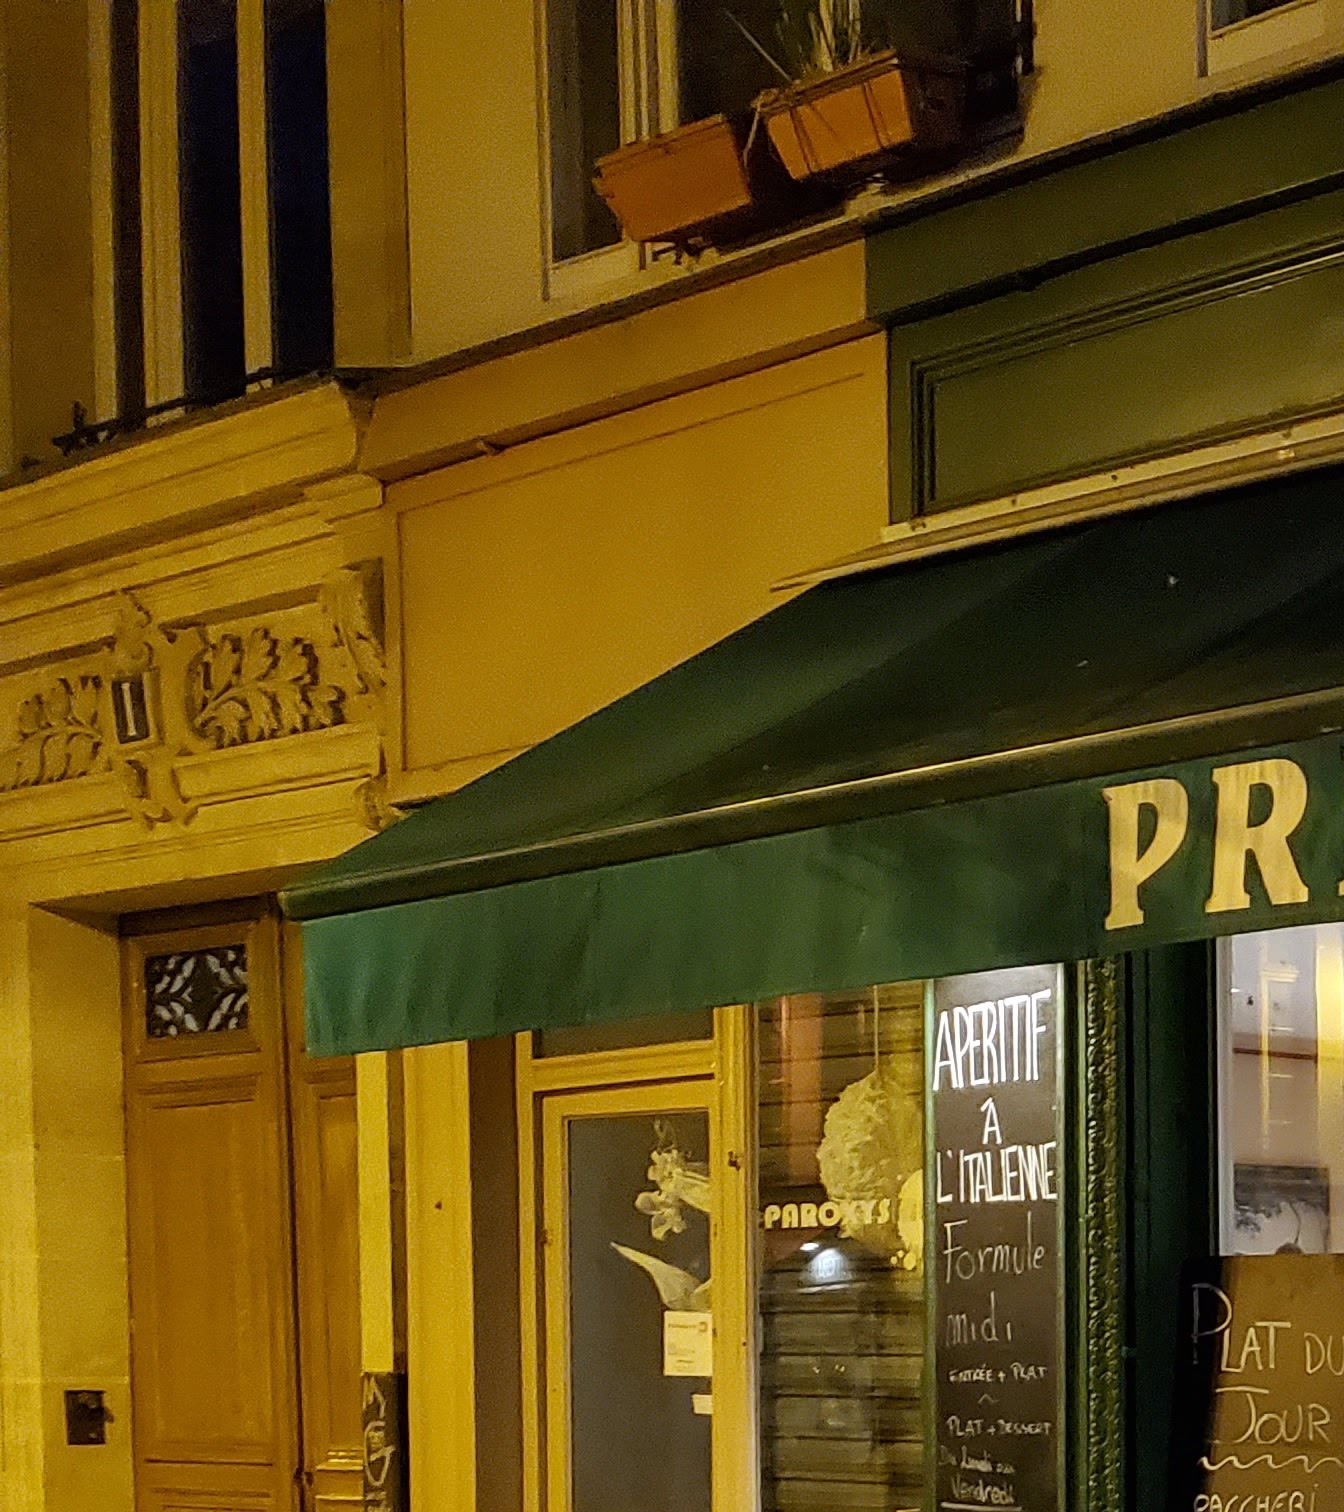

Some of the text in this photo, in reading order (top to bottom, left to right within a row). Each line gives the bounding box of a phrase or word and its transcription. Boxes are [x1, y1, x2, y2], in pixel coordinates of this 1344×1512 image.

[933, 988, 1051, 1091] APERITIF
[937, 1141, 1058, 1204] L'ITALIENNE
[943, 1211, 1045, 1284] Formule
[1192, 1283, 1291, 1373] PLAT
[1009, 1361, 1048, 1381] PLAT
[946, 1415, 984, 1437] PLAT
[1208, 1386, 1330, 1444] JOUR
